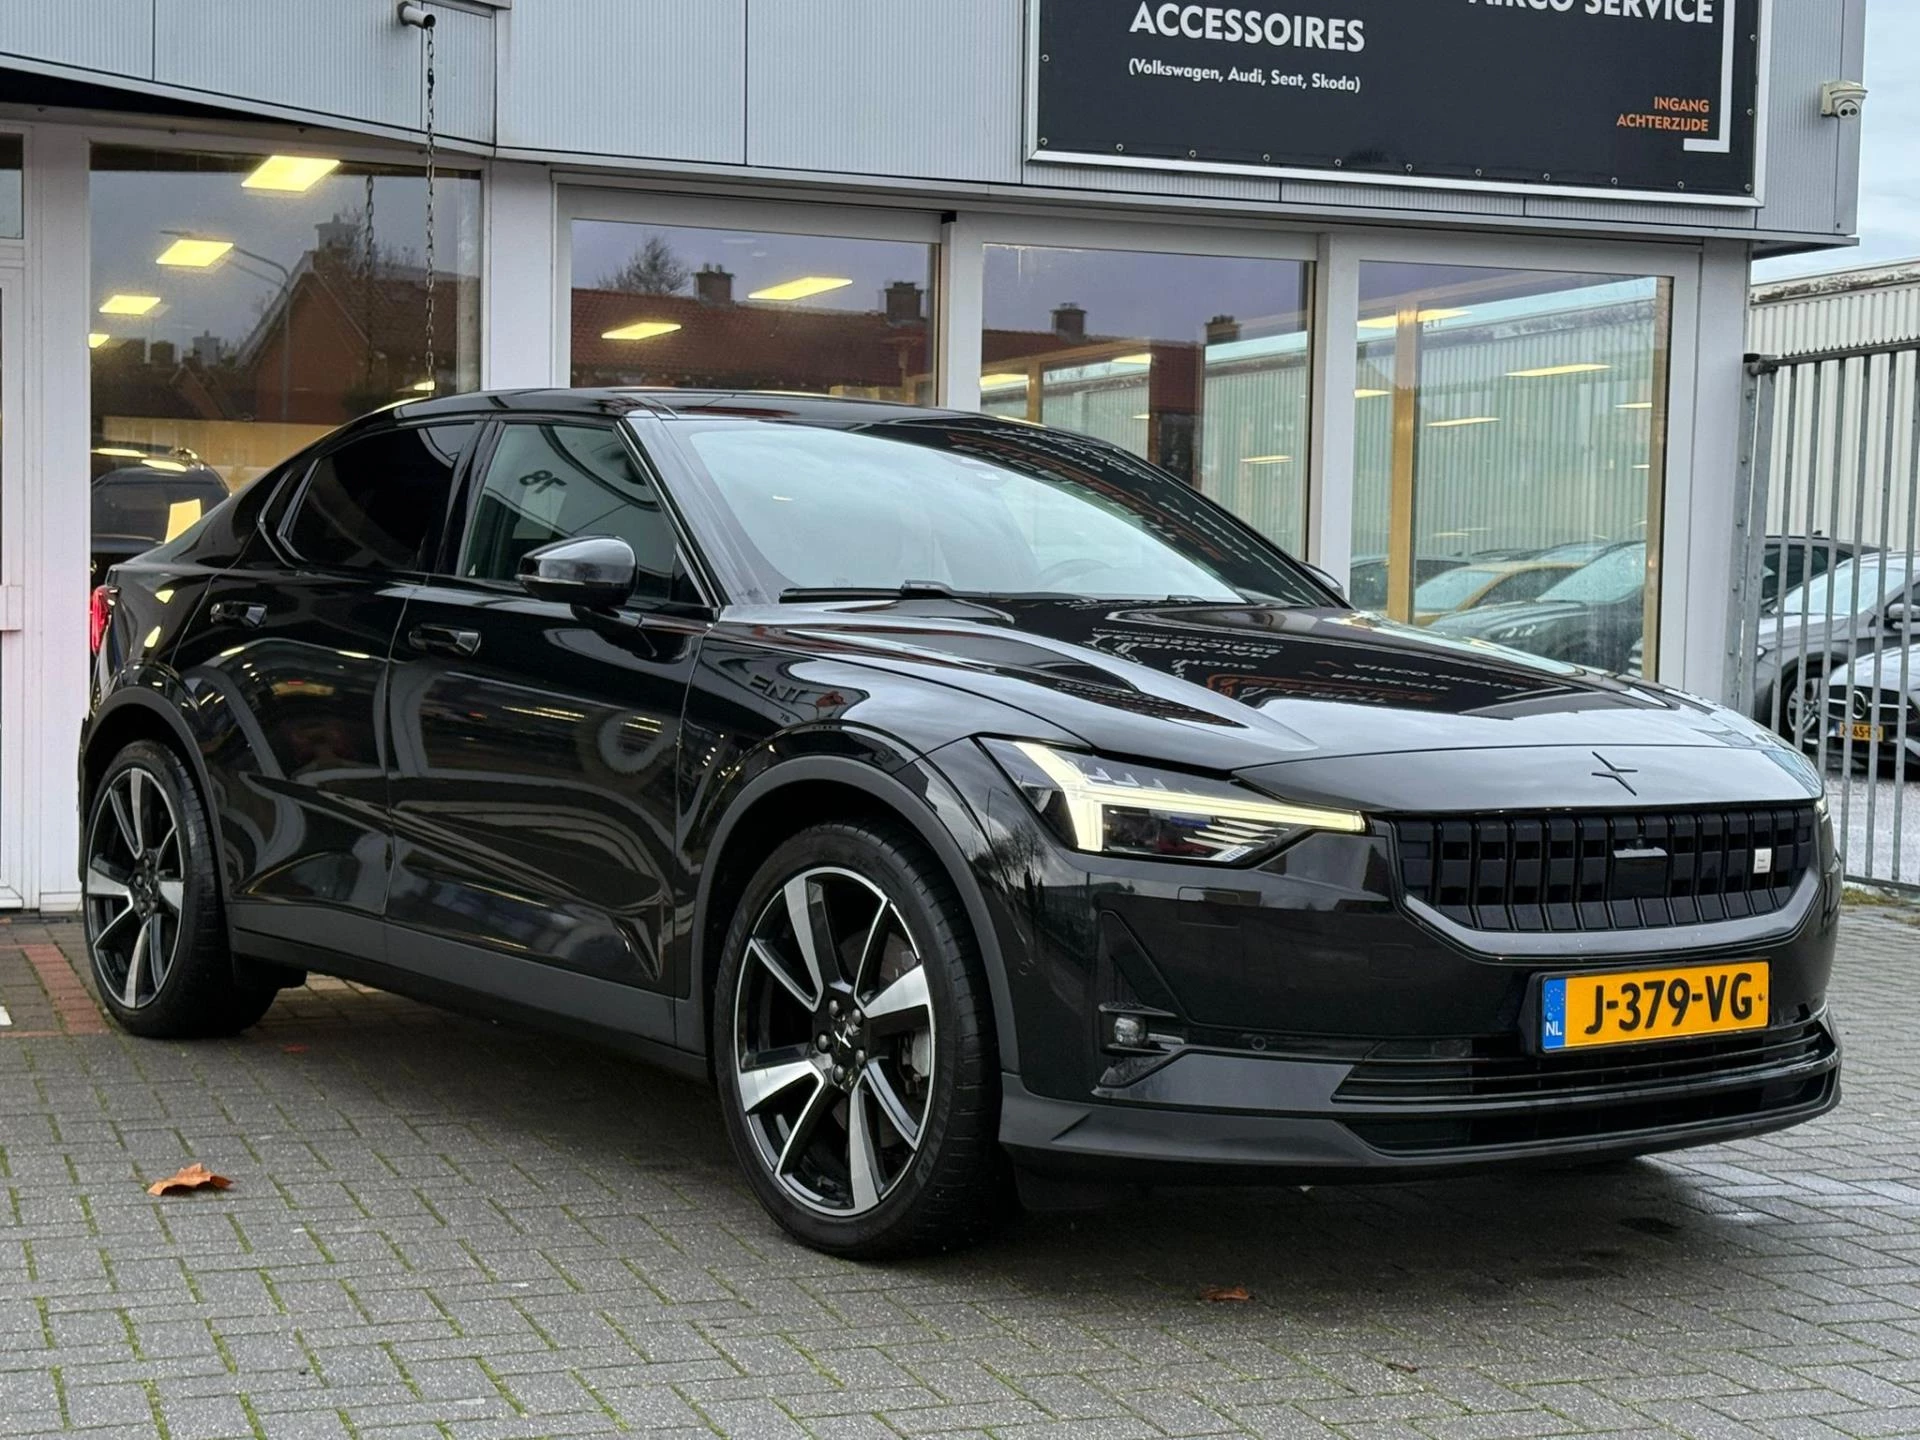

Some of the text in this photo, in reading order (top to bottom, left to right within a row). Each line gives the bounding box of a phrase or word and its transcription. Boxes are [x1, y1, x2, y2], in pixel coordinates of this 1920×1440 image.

[1129, 1, 1365, 52] ACCESSOIRES
[1128, 58, 1361, 93] (Volkswagen, Audi, Seat, Skoda)
[1654, 96, 1710, 113] INGANG
[1616, 113, 1709, 132] ACHTERZIJDE
[1584, 973, 1752, 1035] J-379-VG
[1545, 1021, 1562, 1037] NL
